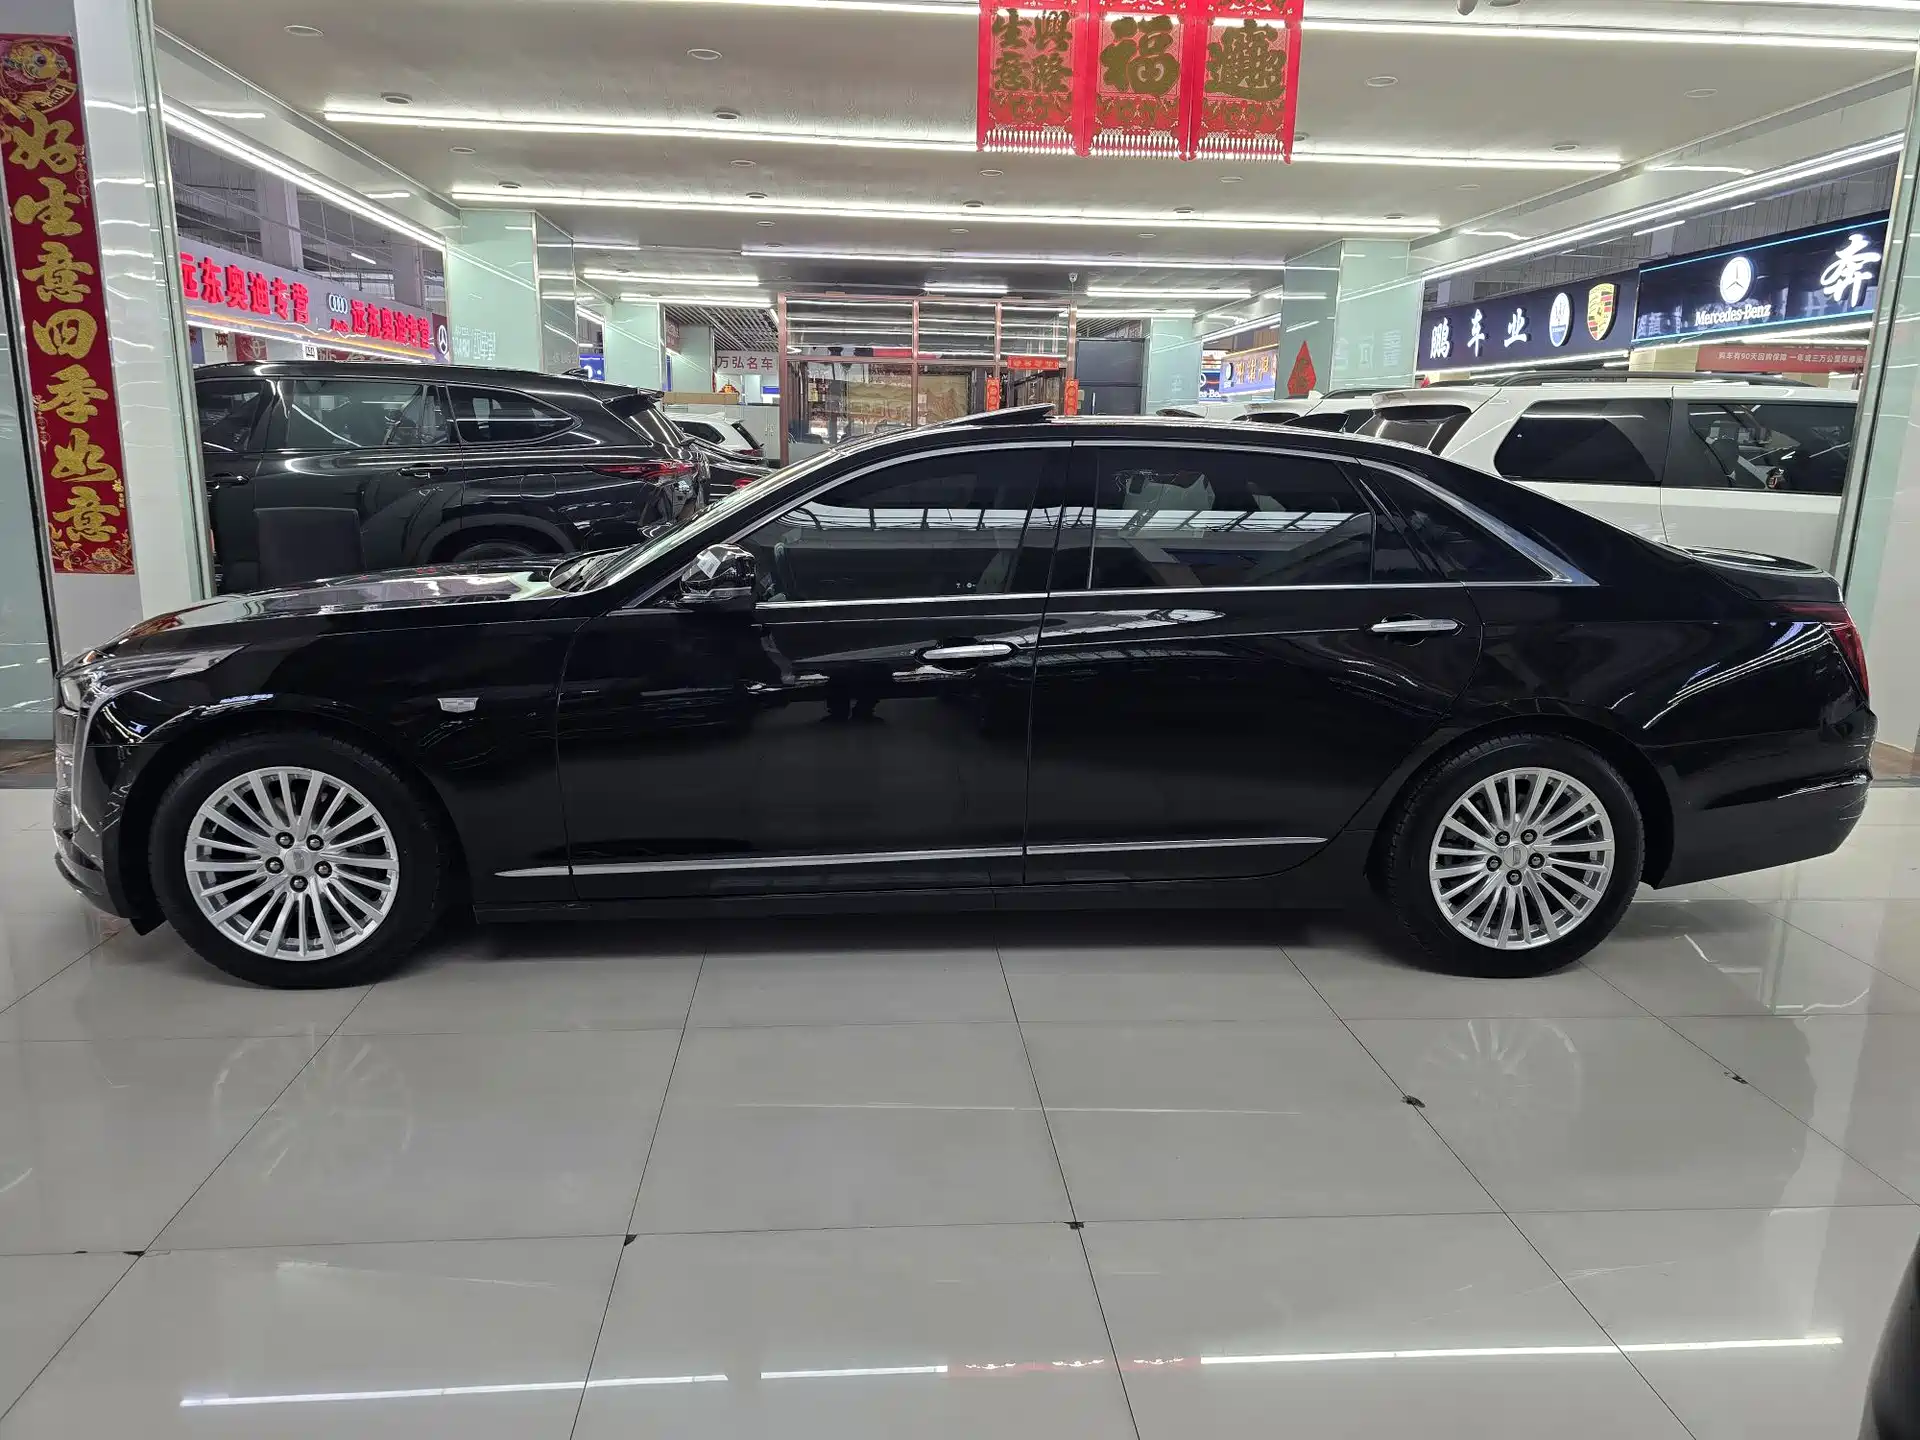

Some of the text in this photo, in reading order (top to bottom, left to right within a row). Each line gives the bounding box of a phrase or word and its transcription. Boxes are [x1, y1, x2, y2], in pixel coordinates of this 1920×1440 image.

[1100, 15, 1181, 96] 福
[8, 108, 121, 542] 好生意四季如意
[1694, 303, 1771, 327] Mercedes-Benz
[717, 355, 774, 370] 万弘名车
